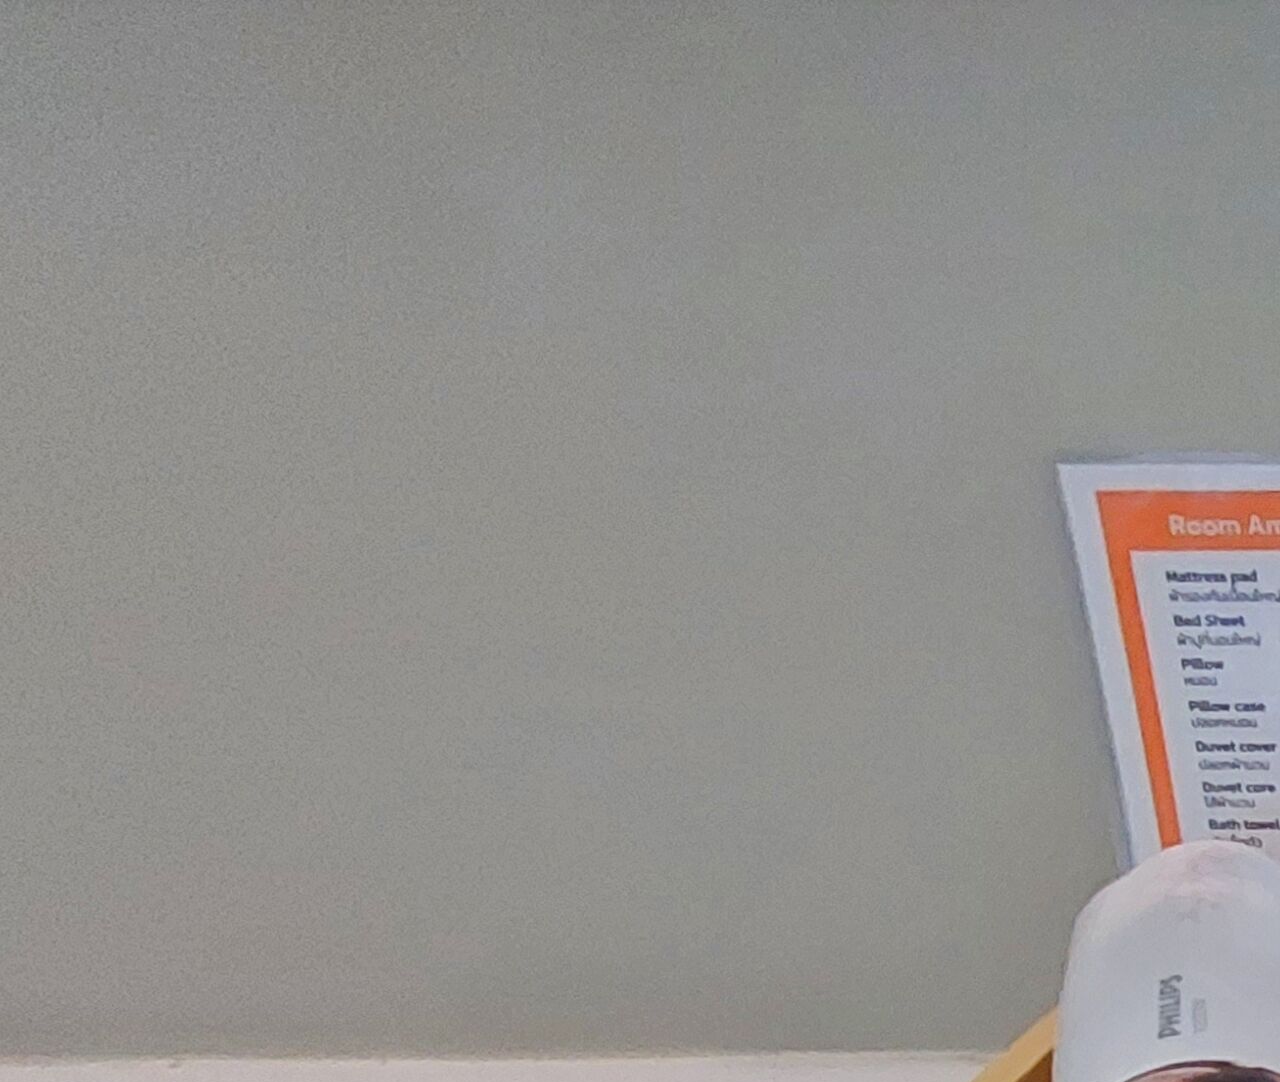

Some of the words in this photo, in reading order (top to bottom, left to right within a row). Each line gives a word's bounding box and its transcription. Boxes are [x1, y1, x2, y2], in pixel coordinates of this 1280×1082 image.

[1168, 514, 1240, 536] Room
[1166, 570, 1227, 584] Mattress
[1231, 570, 1257, 587] pad
[1174, 615, 1202, 627] Bed
[1204, 614, 1245, 627] Sheet
[1181, 658, 1224, 671] Pillow
[1188, 700, 1231, 713] Pillow
[1235, 703, 1265, 713] case
[1195, 741, 1236, 754] Duvet
[1239, 743, 1277, 754] cover
[1202, 782, 1241, 794] Duvet
[1209, 819, 1241, 831] Bath
[1157, 974, 1183, 1039] PHILIPS
